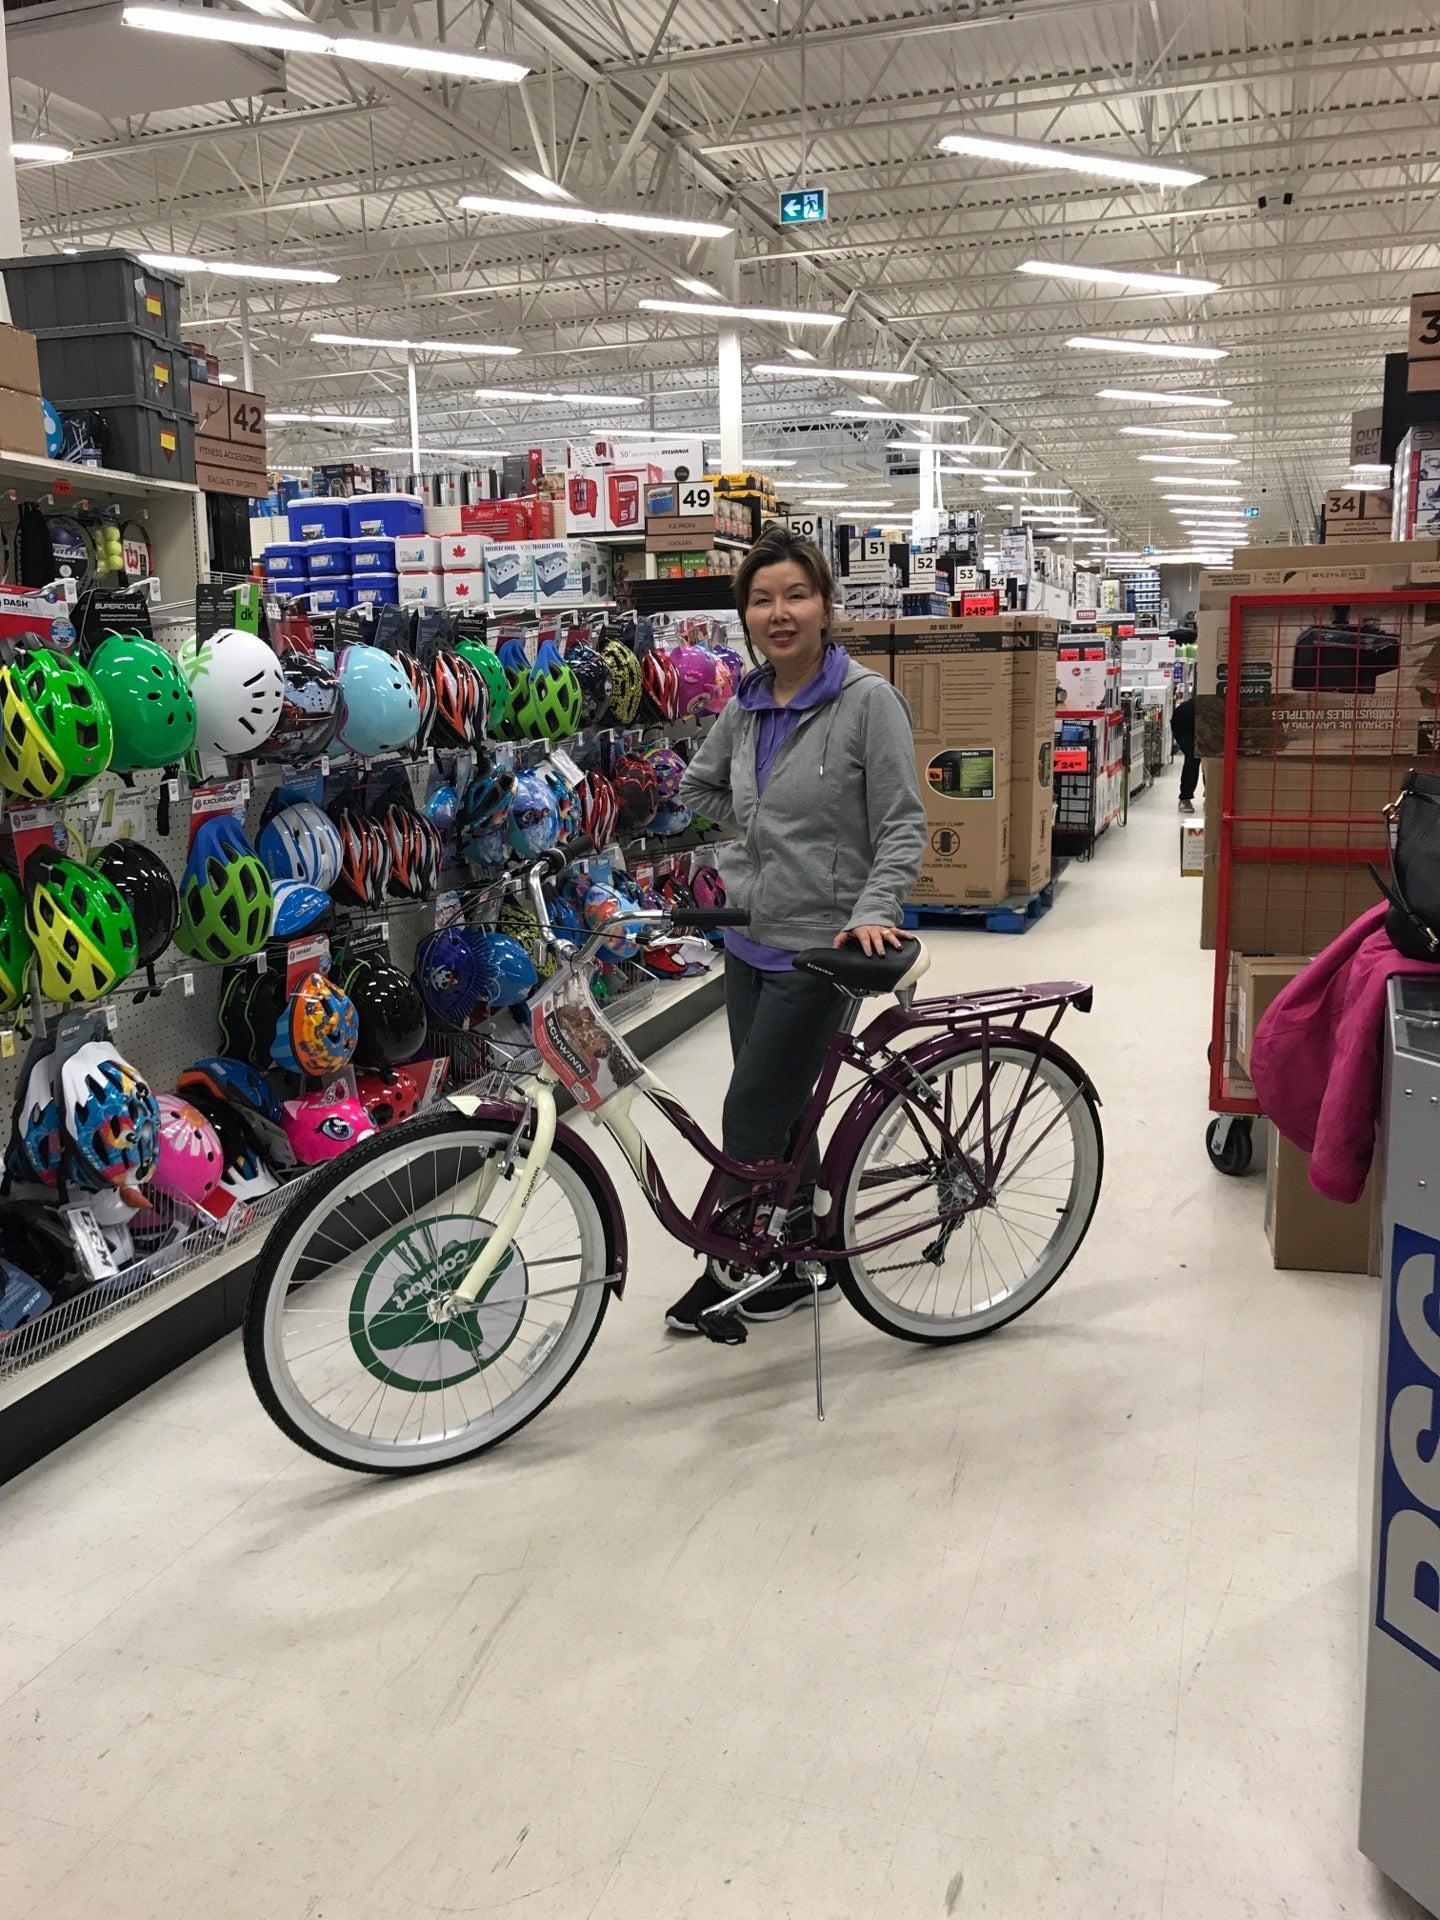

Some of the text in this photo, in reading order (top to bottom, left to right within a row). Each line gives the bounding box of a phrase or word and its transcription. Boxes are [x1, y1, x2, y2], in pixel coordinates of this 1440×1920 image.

[233, 404, 262, 434] 42
[200, 447, 262, 464] FITNESS ACCESSORIES
[207, 475, 258, 490] RACQUET SPORTS
[683, 489, 710, 508] 49
[1329, 497, 1356, 513] 34
[791, 521, 813, 535] 50
[870, 542, 885, 554] 51
[918, 558, 932, 568] 52
[960, 570, 973, 579] 53
[991, 578, 1004, 586] 54
[3, 598, 28, 607] DASH
[95, 602, 142, 611] SUPERCYCLE
[241, 608, 254, 621] dk
[203, 796, 236, 805] EXCURSION
[61, 1025, 80, 1036] CCM
[548, 1017, 585, 1074] SCHWINN
[521, 1167, 541, 1208] SCHWINN
[81, 1210, 113, 1268] CCM
[391, 1249, 469, 1311] comfort
